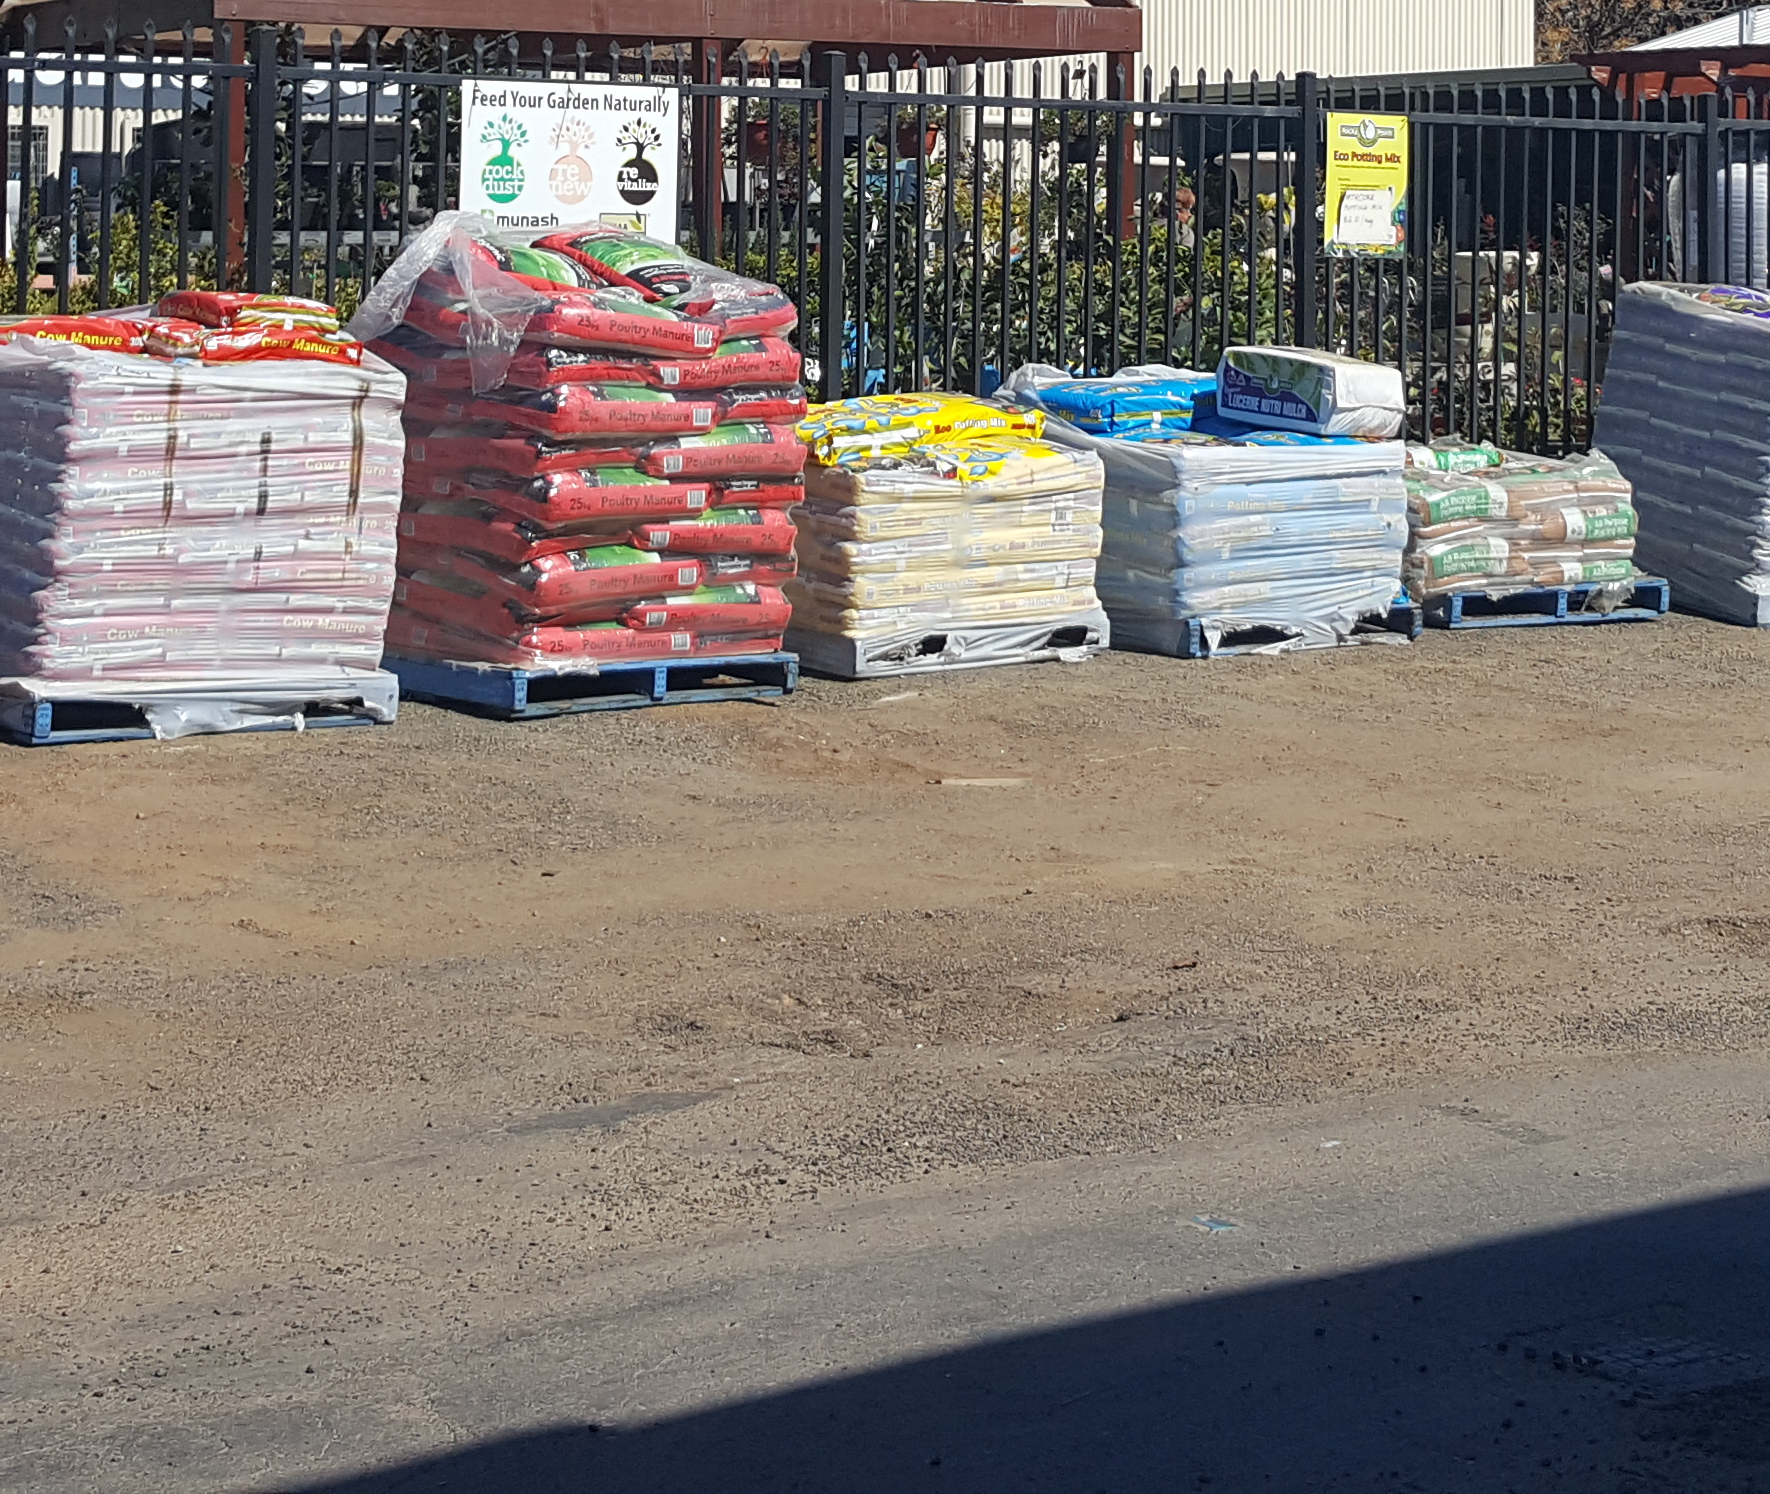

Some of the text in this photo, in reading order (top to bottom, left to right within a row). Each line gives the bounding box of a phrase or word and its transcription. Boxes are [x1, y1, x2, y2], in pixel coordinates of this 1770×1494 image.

[472, 90, 670, 117] Feed Your Garden Naturally
[1333, 150, 1349, 161] Eco
[1351, 151, 1383, 164] Potting
[483, 156, 524, 180] rock
[555, 164, 579, 181] re
[619, 166, 639, 179] re
[483, 177, 524, 195] dust
[550, 179, 593, 197] new
[616, 178, 660, 191] vitalize
[496, 212, 559, 227] munash
[35, 330, 68, 341] Cow
[71, 331, 123, 347] Manure
[609, 319, 650, 337] Poultry
[652, 326, 692, 342] Manure
[261, 336, 291, 349] Cow
[292, 337, 340, 355] Manure
[683, 367, 720, 381] Poultry
[721, 363, 761, 376] Manure
[1229, 392, 1260, 410] LUCERNE
[1283, 400, 1308, 418] MULCH
[609, 410, 648, 424] Poultry
[650, 411, 690, 423] Manure
[954, 418, 988, 430] Potting
[989, 417, 1007, 427] Mix
[304, 458, 388, 476] Cow Mure
[686, 456, 723, 468] Poultry
[725, 454, 764, 466] Manure
[601, 495, 640, 508] Poultry
[642, 494, 684, 506] Manure
[673, 534, 710, 547] Poultry
[589, 576, 630, 591] Poultry
[632, 573, 675, 586] Manure
[283, 615, 367, 634] Cow Manure
[107, 628, 139, 641] Cow
[582, 638, 622, 651] Poultry
[624, 637, 668, 650] Manure
